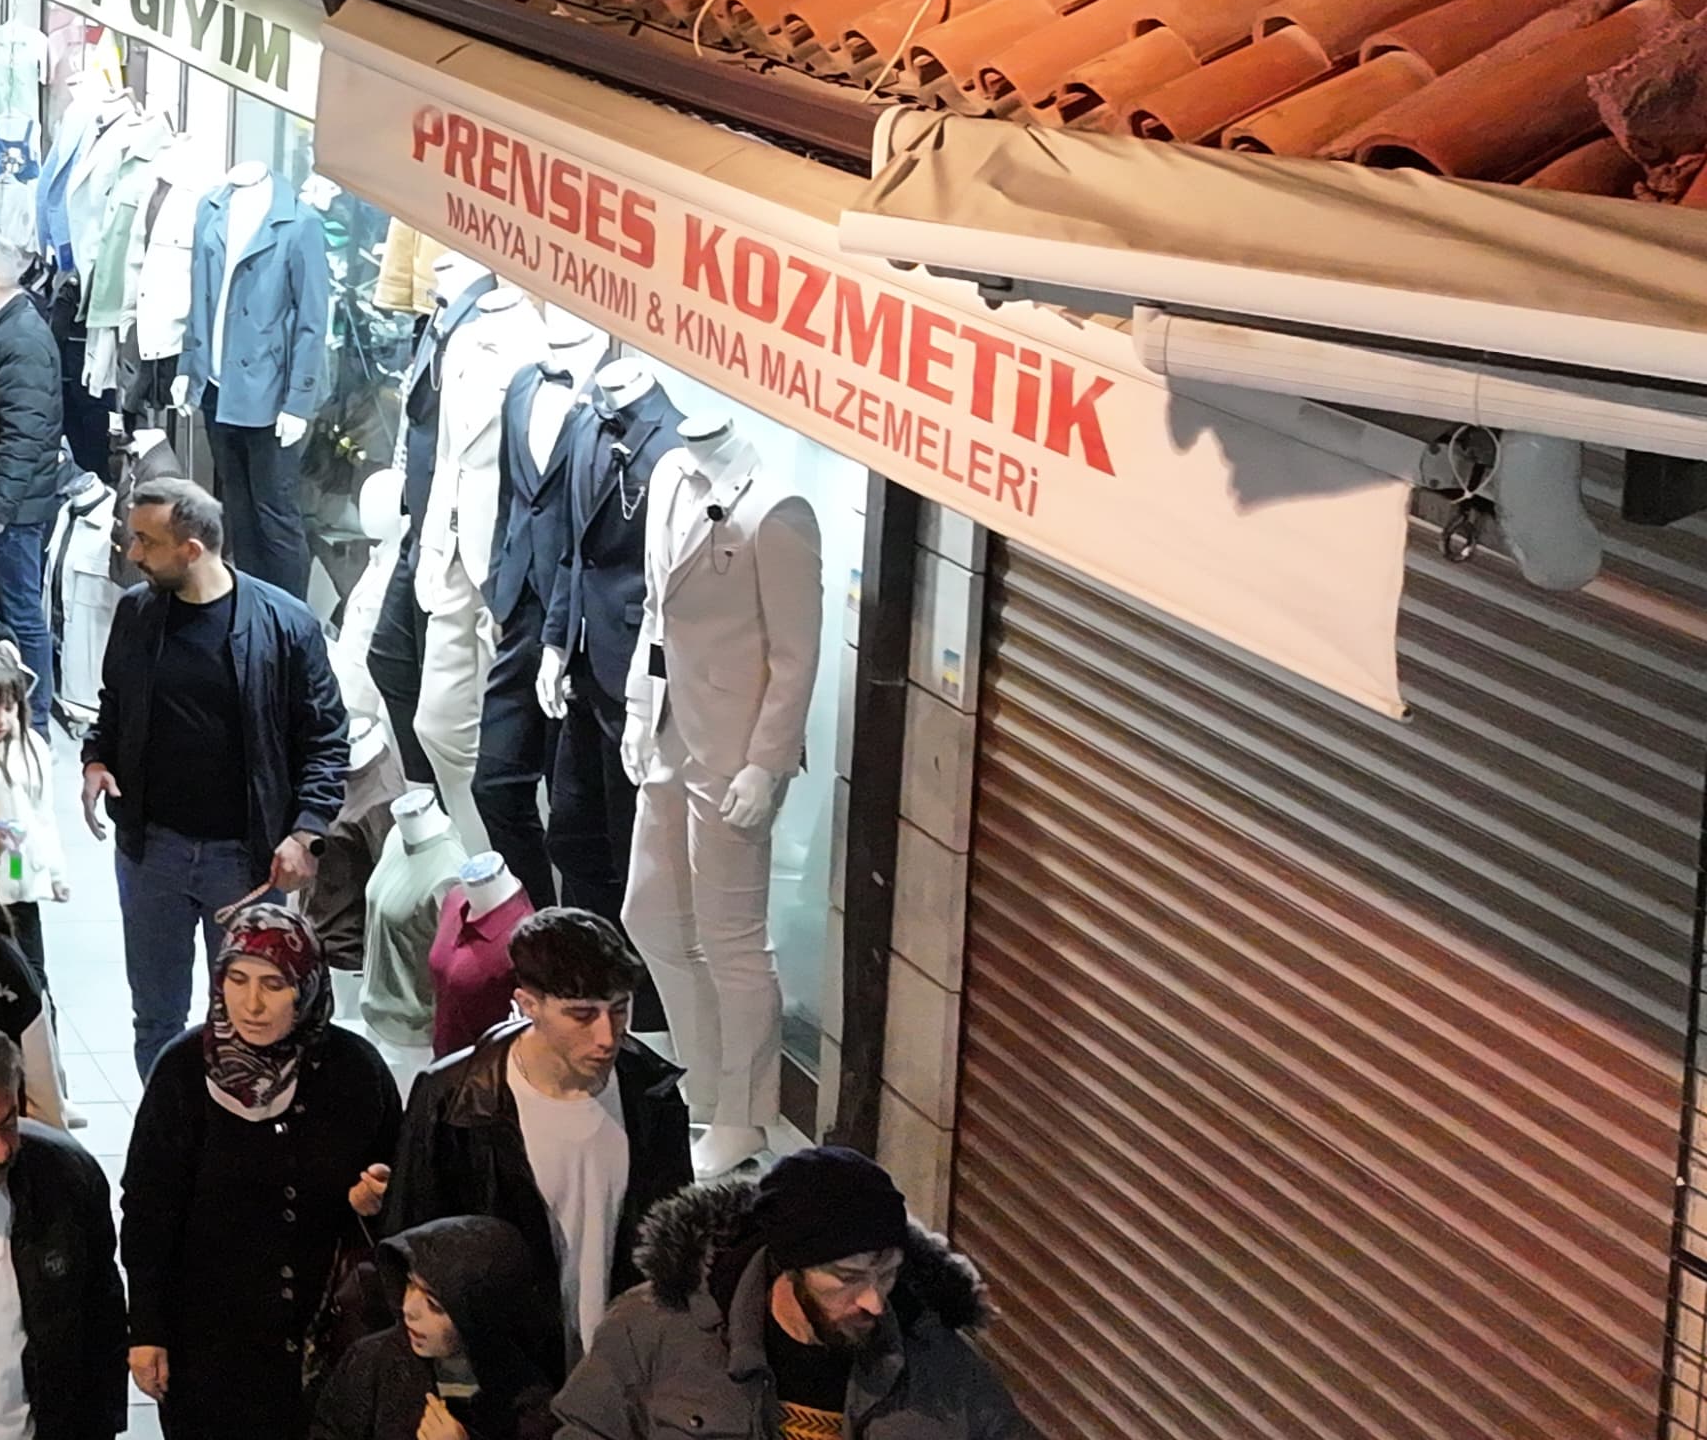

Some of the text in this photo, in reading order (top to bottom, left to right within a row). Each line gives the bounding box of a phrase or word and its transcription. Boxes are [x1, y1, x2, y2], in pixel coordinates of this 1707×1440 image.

[412, 104, 657, 270] PRENSES
[446, 192, 541, 272] MAKYAJ
[549, 242, 637, 322] TAKIMI
[646, 291, 665, 337] &
[676, 304, 750, 379] KINA
